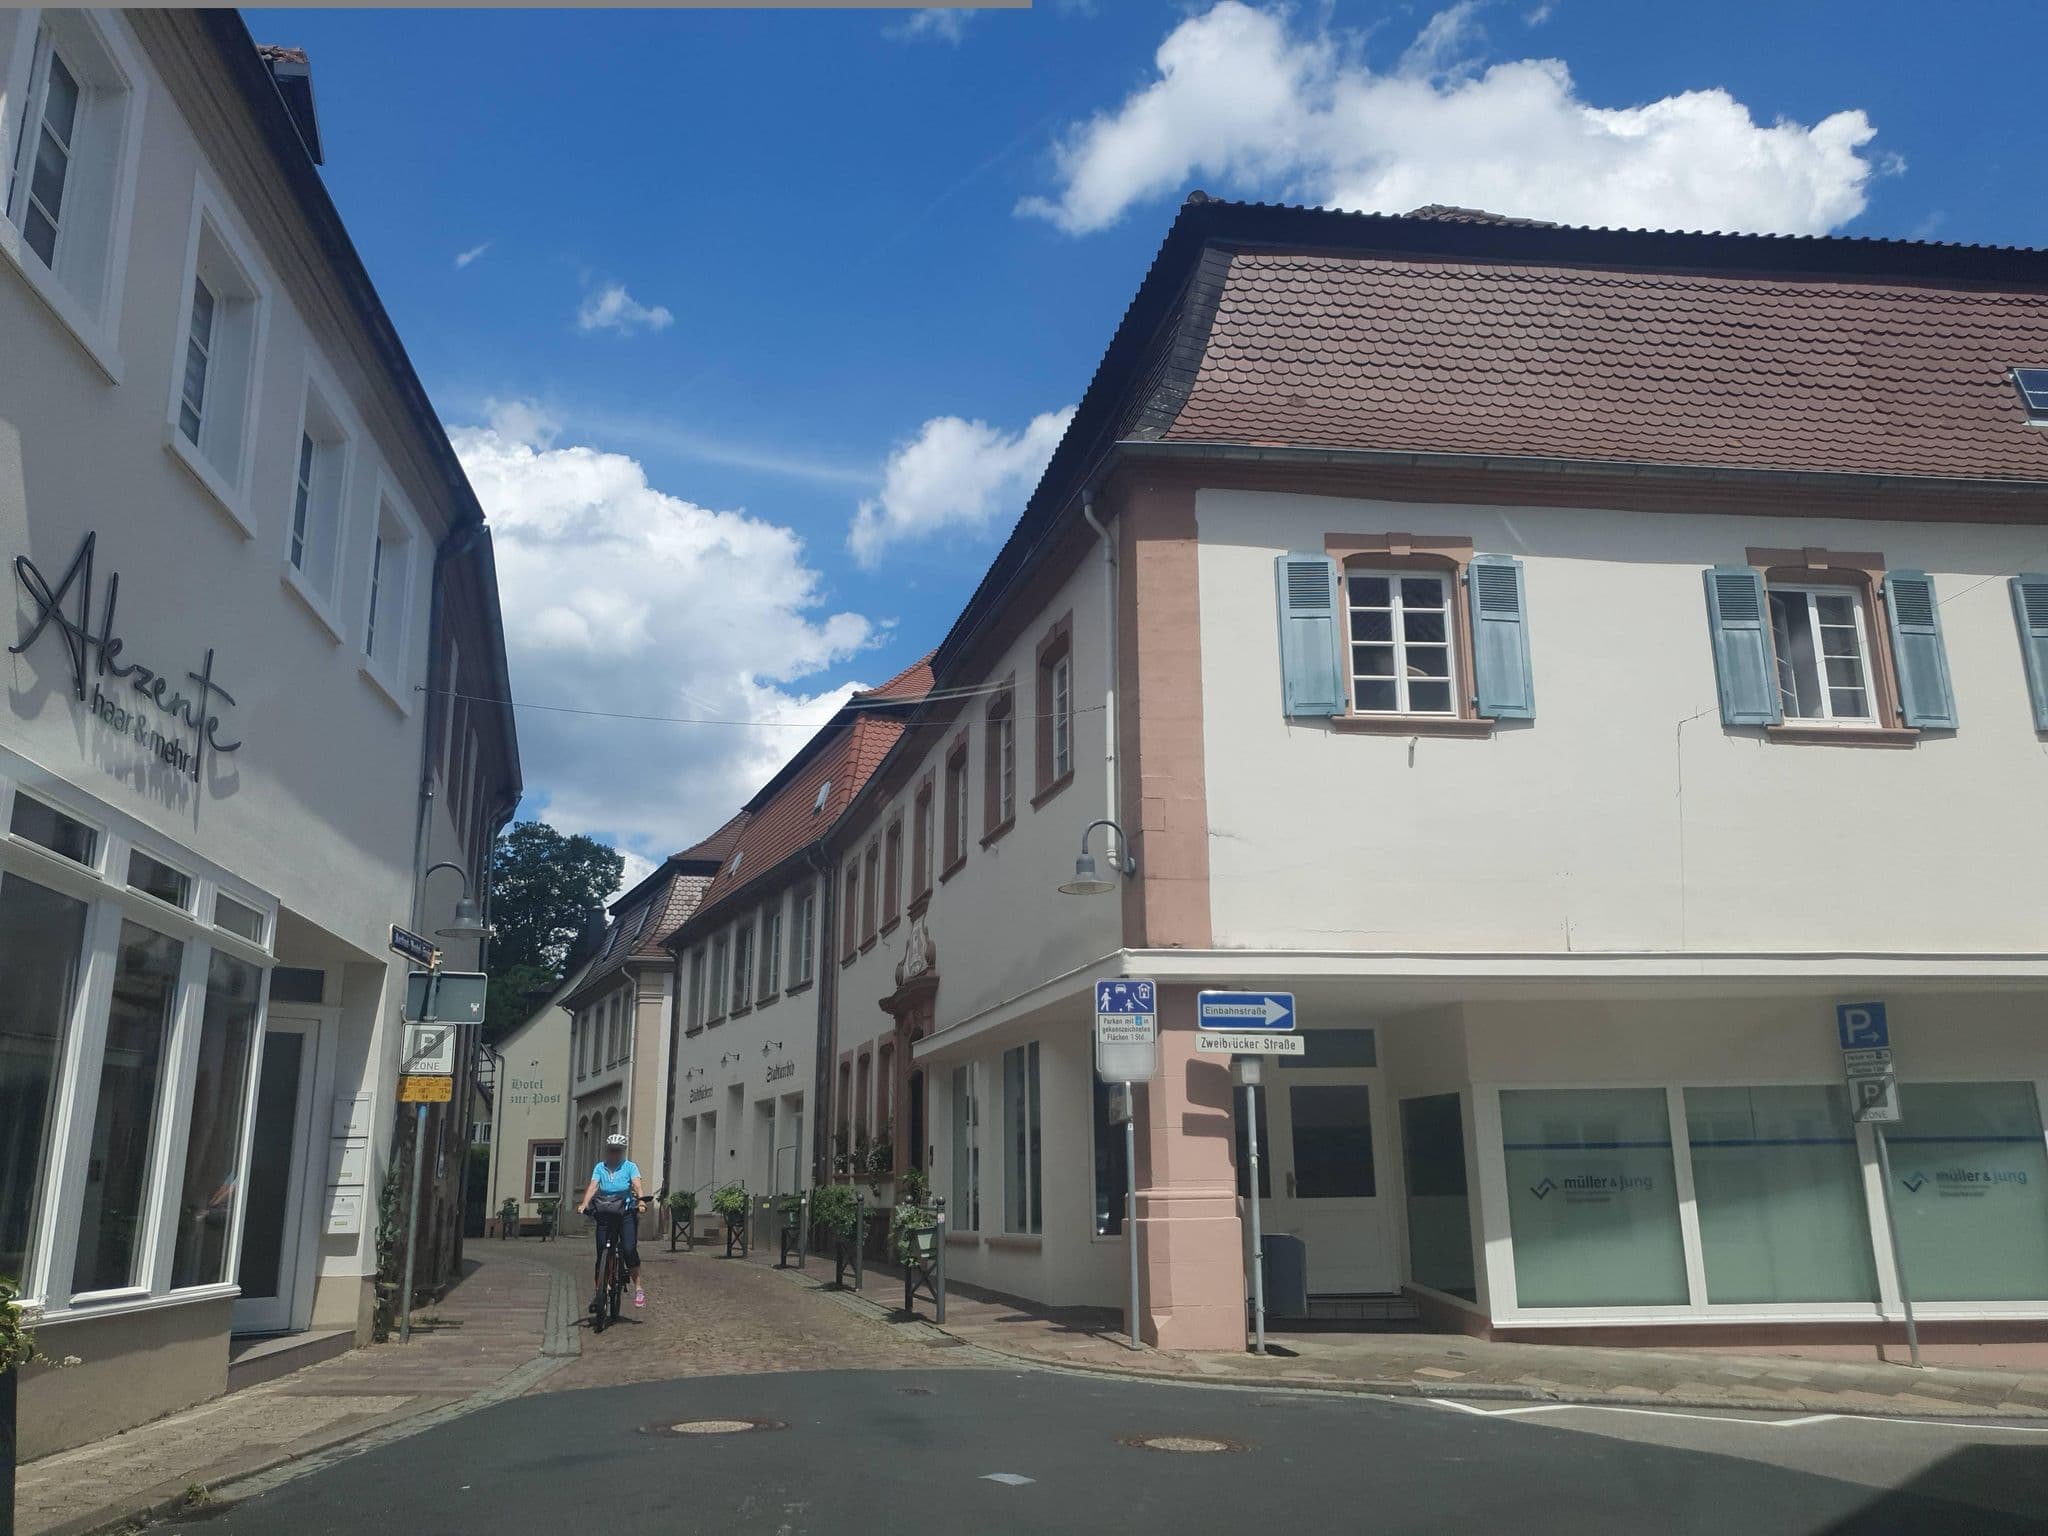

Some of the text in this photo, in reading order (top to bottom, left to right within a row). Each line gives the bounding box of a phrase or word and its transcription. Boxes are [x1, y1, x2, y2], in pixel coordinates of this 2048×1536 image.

[8, 530, 242, 784] Akzente
[91, 683, 135, 735] haar
[149, 729, 192, 773] mehr
[1205, 1007, 1267, 1016] Einbahnstraße
[1264, 1039, 1296, 1050] Straße
[414, 1062, 440, 1070] ZONE
[532, 1093, 561, 1105] Post
[1864, 1110, 1888, 1119] ZONE
[1936, 1168, 1980, 1182] müller
[1993, 1170, 2027, 1185] jung
[1564, 1175, 1607, 1189] müller
[1620, 1175, 1653, 1191] jung
